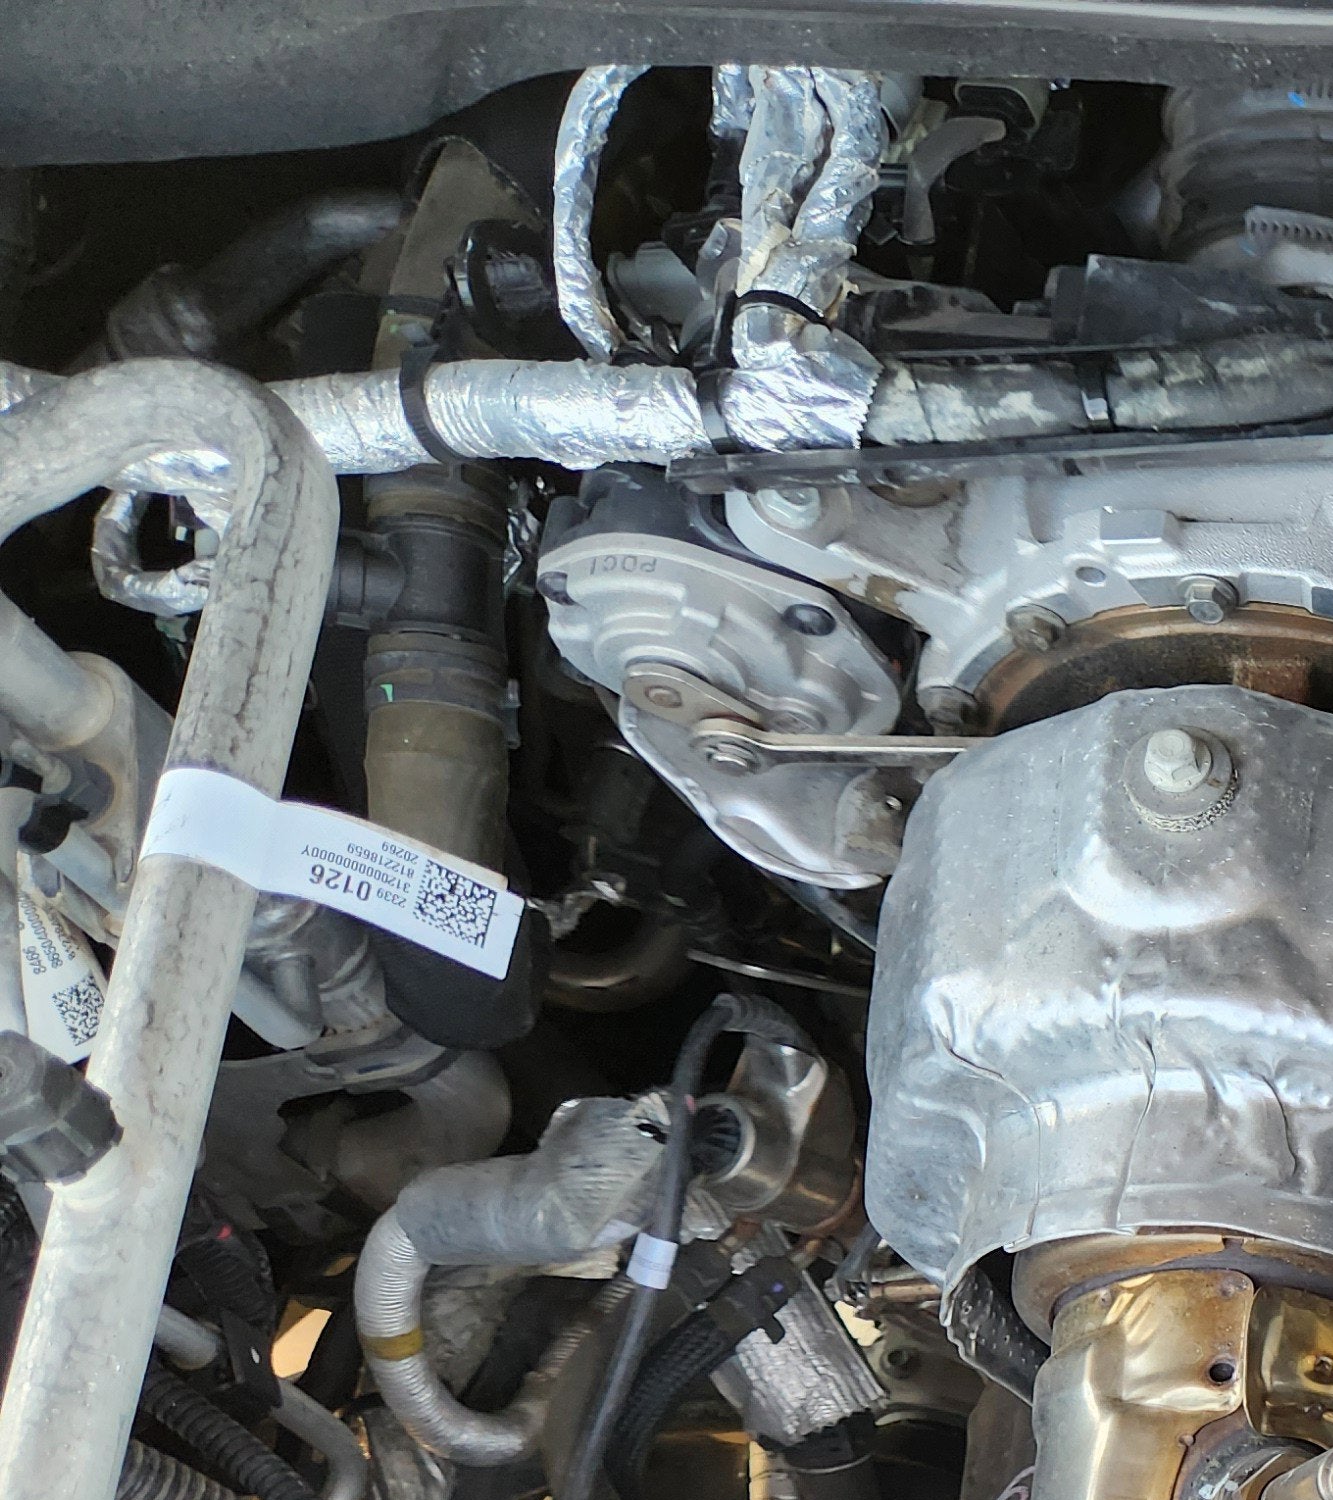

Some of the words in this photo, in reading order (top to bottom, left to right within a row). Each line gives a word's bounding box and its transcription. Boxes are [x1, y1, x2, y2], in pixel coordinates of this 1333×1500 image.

[346, 842, 415, 878] 812218659
[381, 841, 420, 864] 20269
[309, 863, 372, 901] 0126
[377, 886, 408, 909] 2339
